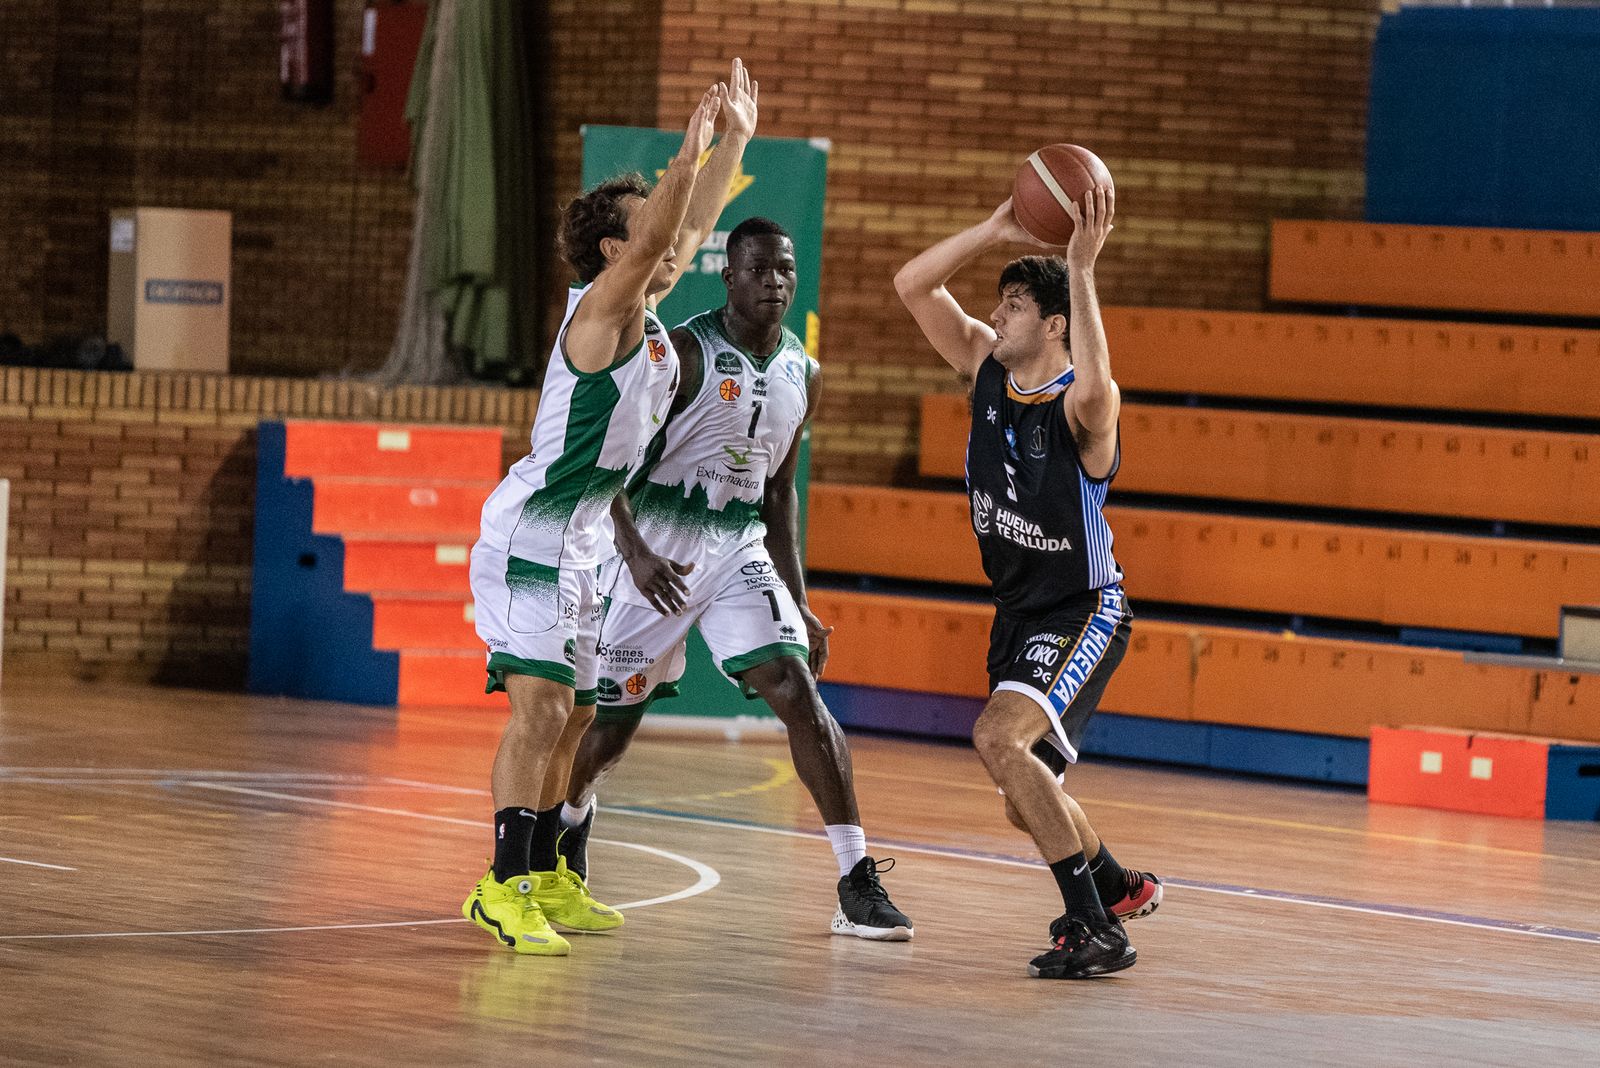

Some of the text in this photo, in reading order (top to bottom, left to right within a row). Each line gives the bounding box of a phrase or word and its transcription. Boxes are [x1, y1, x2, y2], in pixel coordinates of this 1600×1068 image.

[696, 465, 760, 490] Extremadura
[996, 508, 1045, 538] HUELVA
[996, 522, 1073, 552] TE SALUDA
[744, 575, 782, 586] TOYOTA
[762, 589, 782, 622] 1
[609, 656, 655, 665] ydeporte
[1025, 643, 1060, 667] ORO
[1053, 624, 1109, 706] HUELVA
